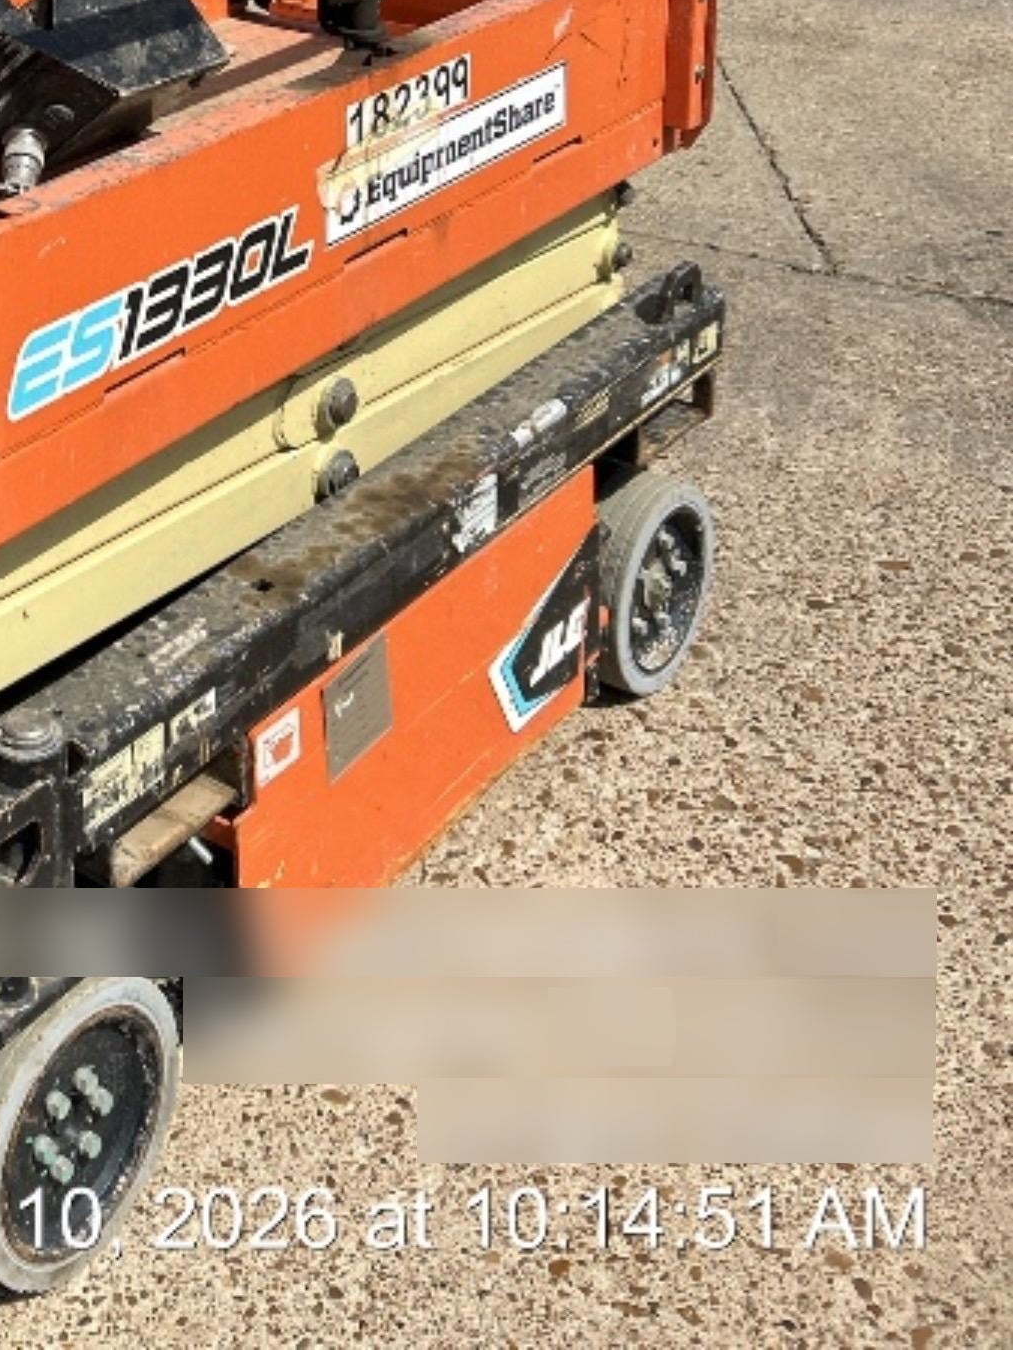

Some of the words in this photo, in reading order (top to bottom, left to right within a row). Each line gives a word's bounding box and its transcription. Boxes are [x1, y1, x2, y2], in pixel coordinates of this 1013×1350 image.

[366, 91, 557, 206] EquipmentShare
[8, 204, 314, 423] ES1330L
[529, 596, 590, 688] JLG
